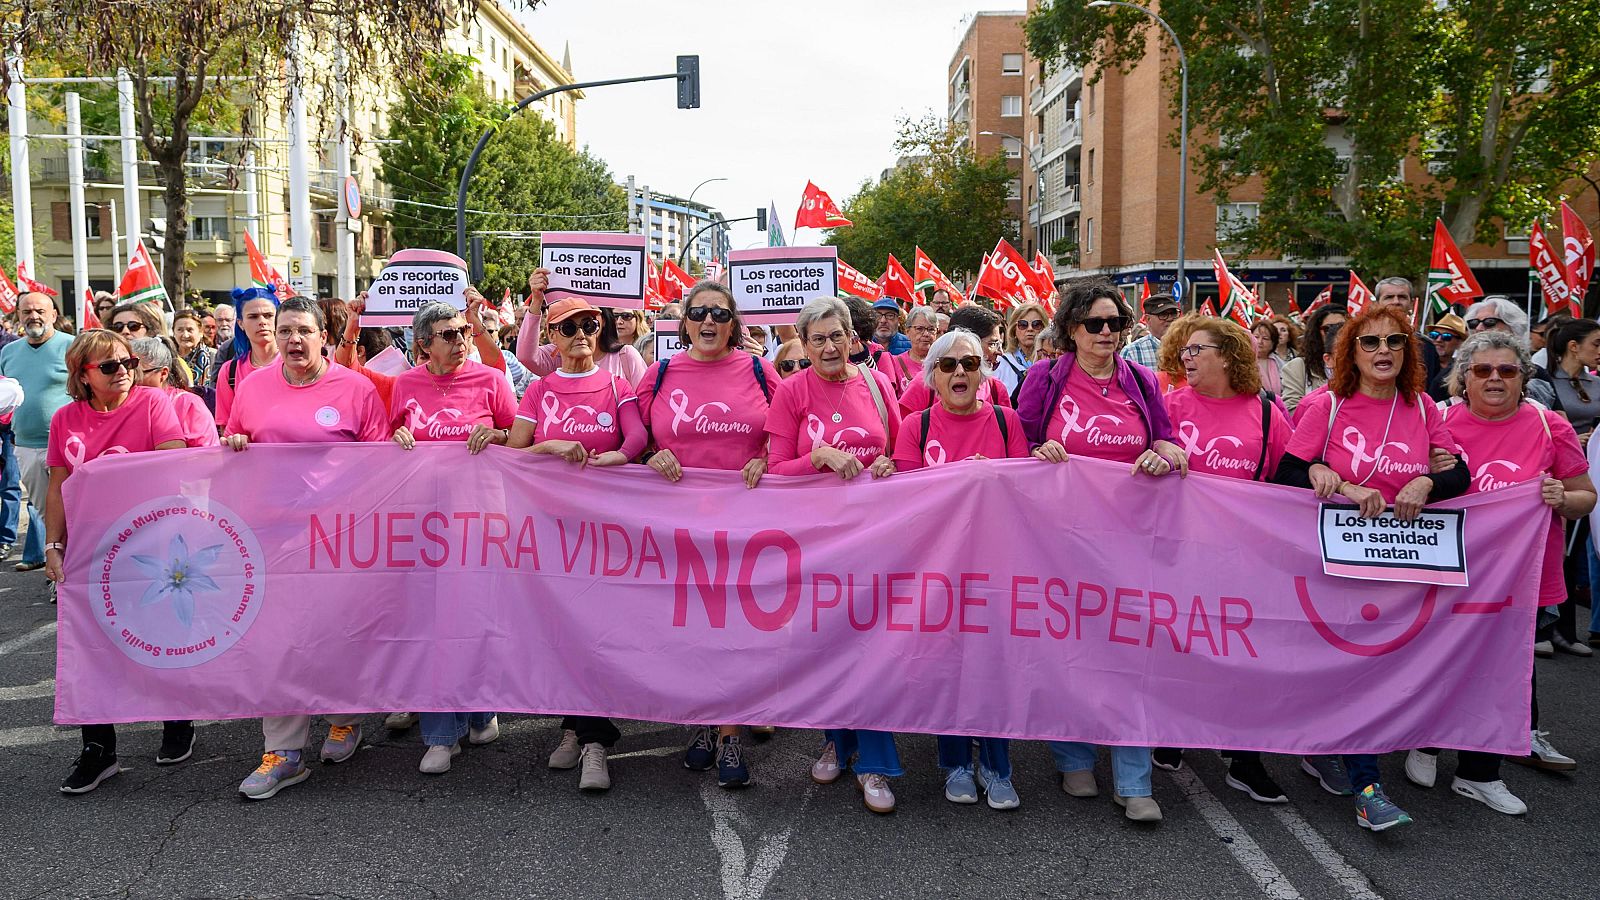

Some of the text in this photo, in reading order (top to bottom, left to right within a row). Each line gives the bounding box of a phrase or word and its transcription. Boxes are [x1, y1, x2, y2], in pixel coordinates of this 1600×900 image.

[550, 251, 632, 266] Los recortes
[292, 260, 300, 274] 5
[555, 265, 627, 279] en sanidad
[740, 265, 825, 281] Los recortes
[990, 250, 1027, 287] UGT
[402, 269, 460, 281] recortes
[378, 283, 454, 295] en sanidad
[570, 279, 611, 291] matan
[745, 279, 820, 294] en sanidad
[853, 282, 876, 296] Sevilla
[762, 294, 805, 307] matan
[428, 420, 478, 439] Amam
[695, 414, 752, 434] Amama
[1086, 426, 1144, 446] Amama
[1205, 448, 1258, 472] Amama
[1334, 513, 1445, 530] Los recortes
[1342, 531, 1438, 546] en sanidad
[1364, 546, 1420, 560] matan
[100, 506, 255, 624] Asociación de Mujeres con Cáncer de Mama
[308, 511, 1259, 658] NUESTRA VIDA NO PUEDE ESPERAR
[121, 628, 217, 657] Amama Sevilla
